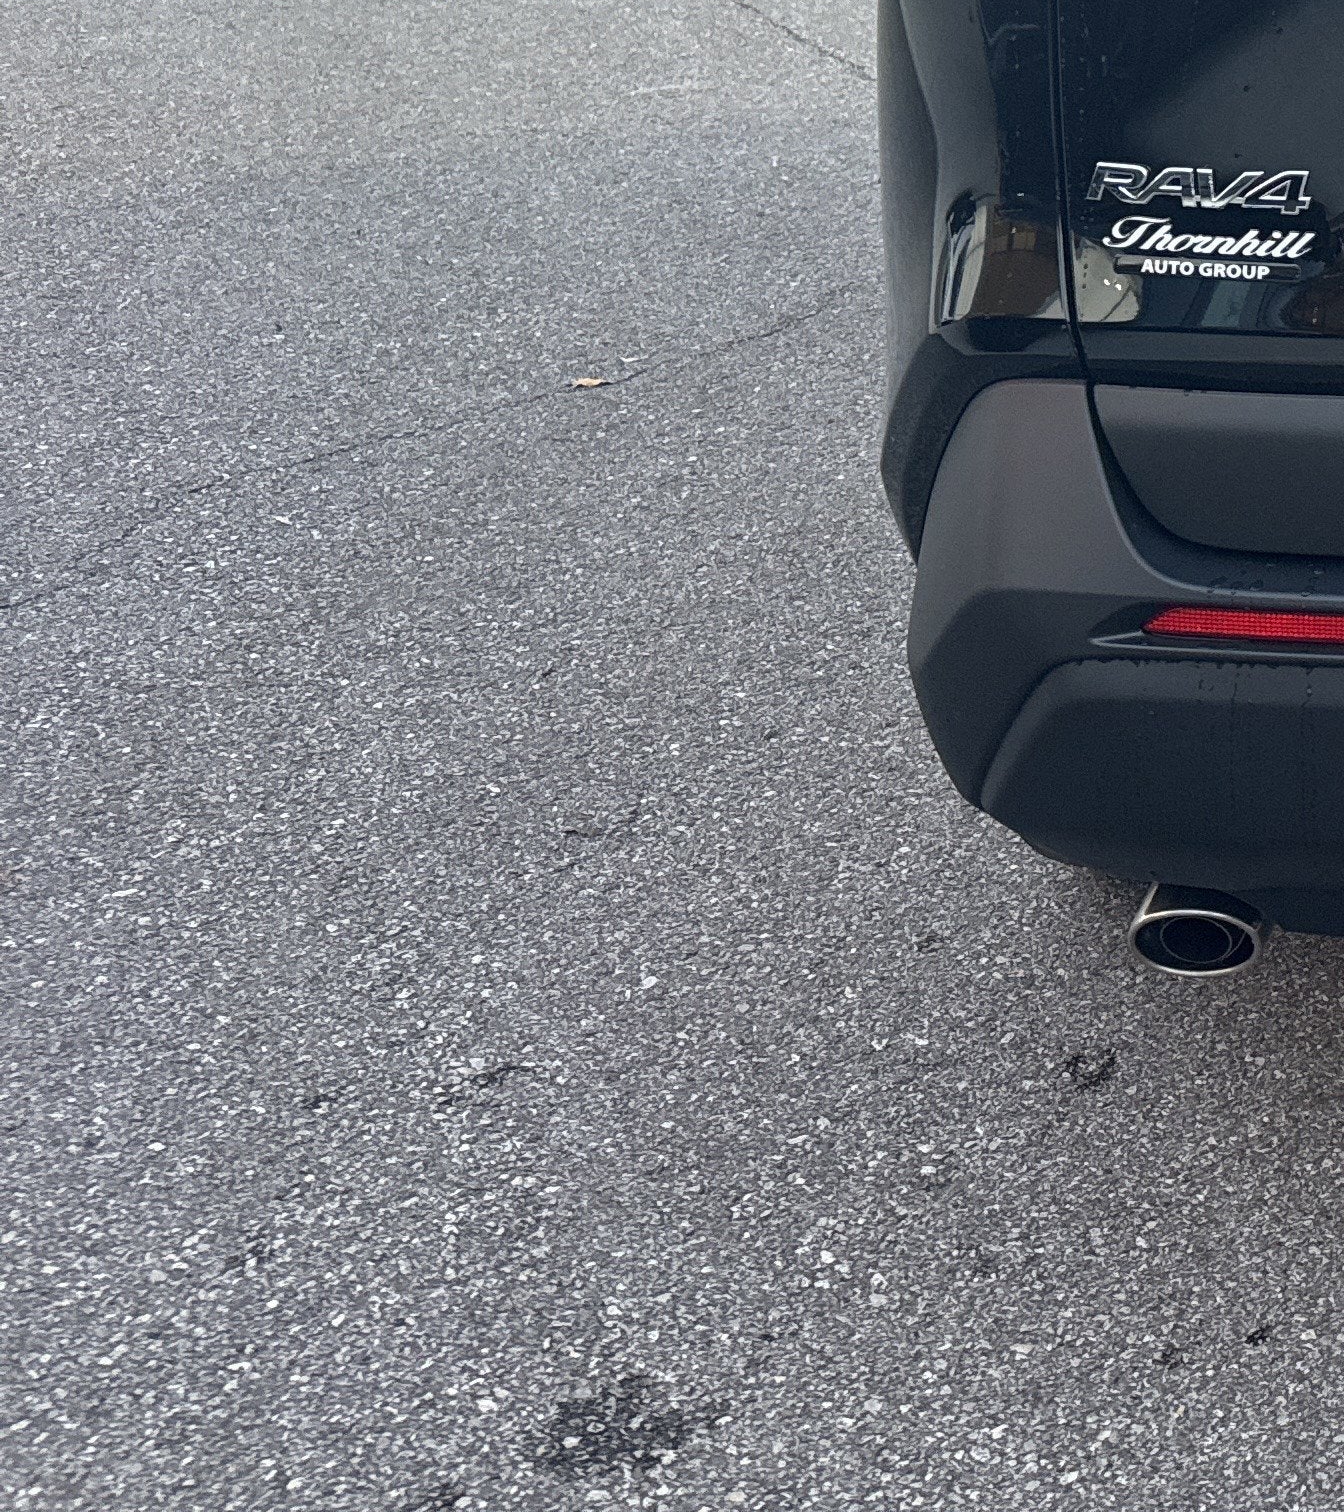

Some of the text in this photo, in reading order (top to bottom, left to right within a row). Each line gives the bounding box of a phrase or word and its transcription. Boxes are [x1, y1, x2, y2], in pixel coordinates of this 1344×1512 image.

[1085, 161, 1312, 216] RAV4
[1102, 215, 1317, 259] Thornhill
[1140, 258, 1271, 280] AUTO GROUP
